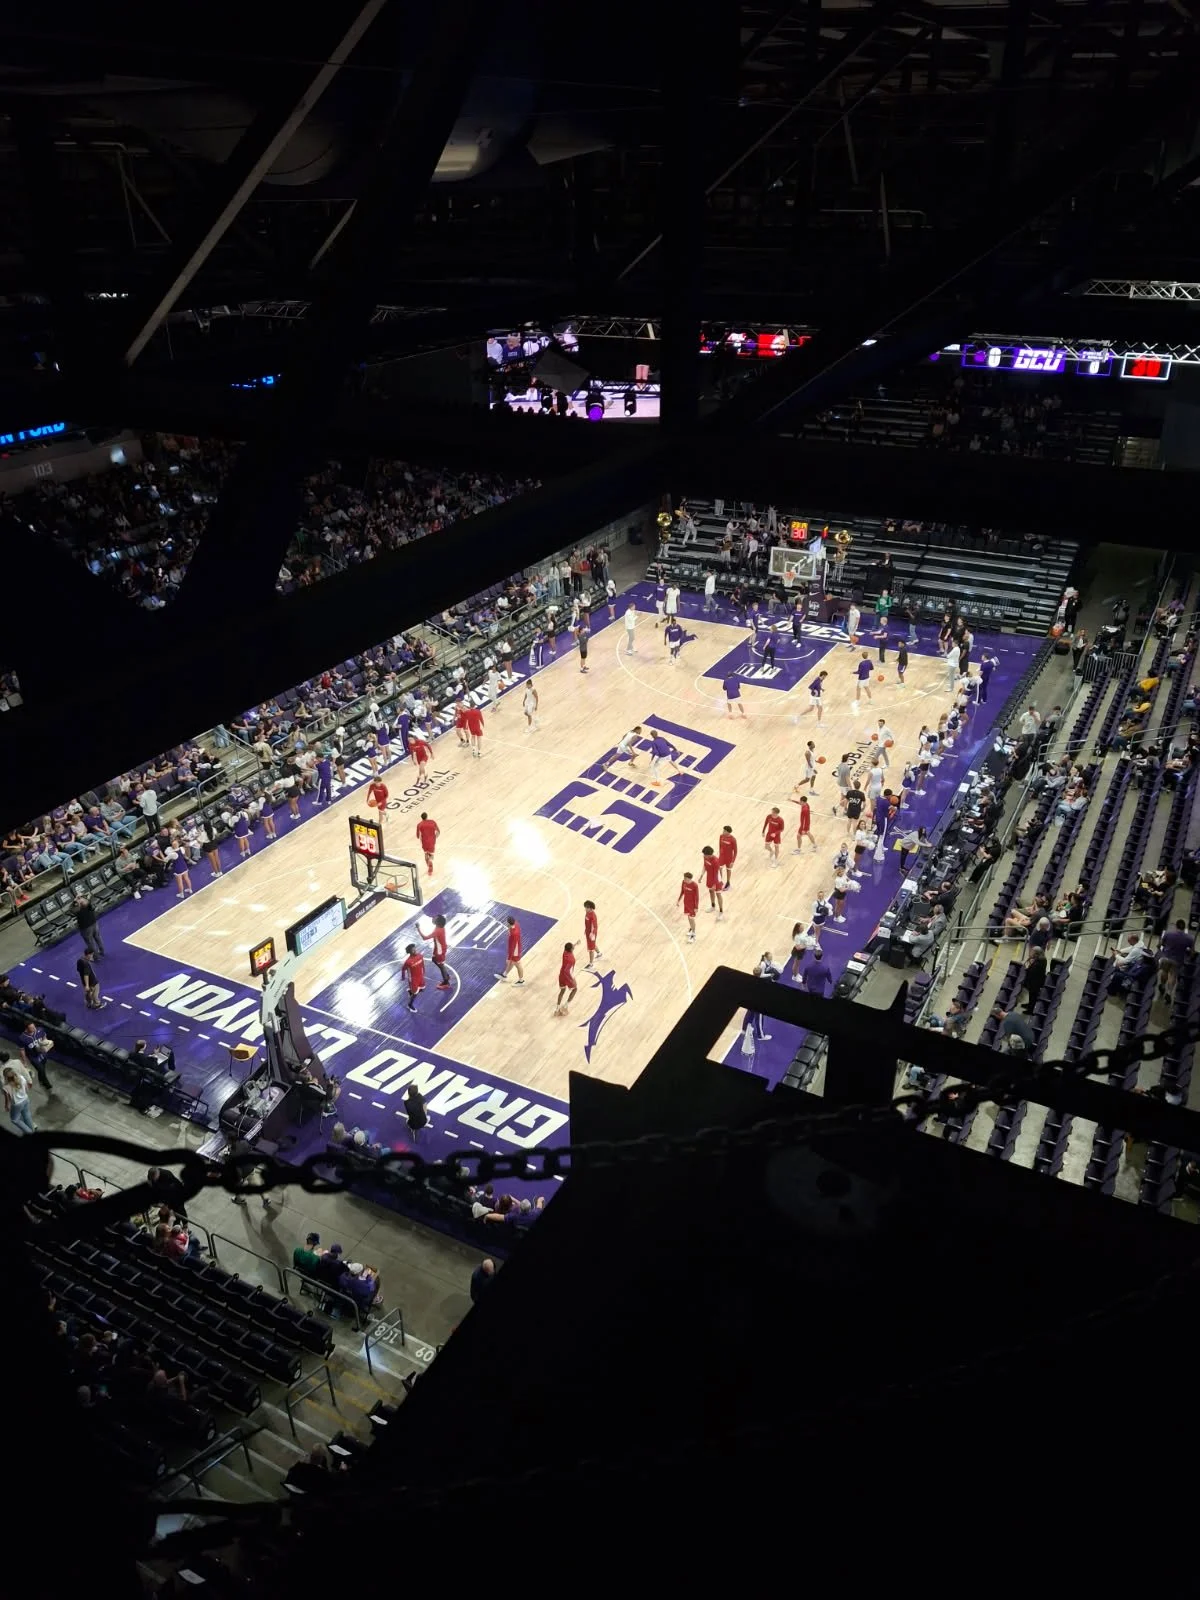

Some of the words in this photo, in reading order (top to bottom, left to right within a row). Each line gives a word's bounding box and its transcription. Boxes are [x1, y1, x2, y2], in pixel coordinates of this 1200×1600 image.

[1013, 349, 1063, 371] GCU
[33, 462, 53, 478] 103
[792, 529, 806, 538] 30
[386, 770, 450, 810] GLOBAL
[400, 791, 433, 813] CREDIT
[431, 771, 460, 790] UNION
[136, 973, 358, 1063] CNYON
[346, 1049, 569, 1149] GRAND
